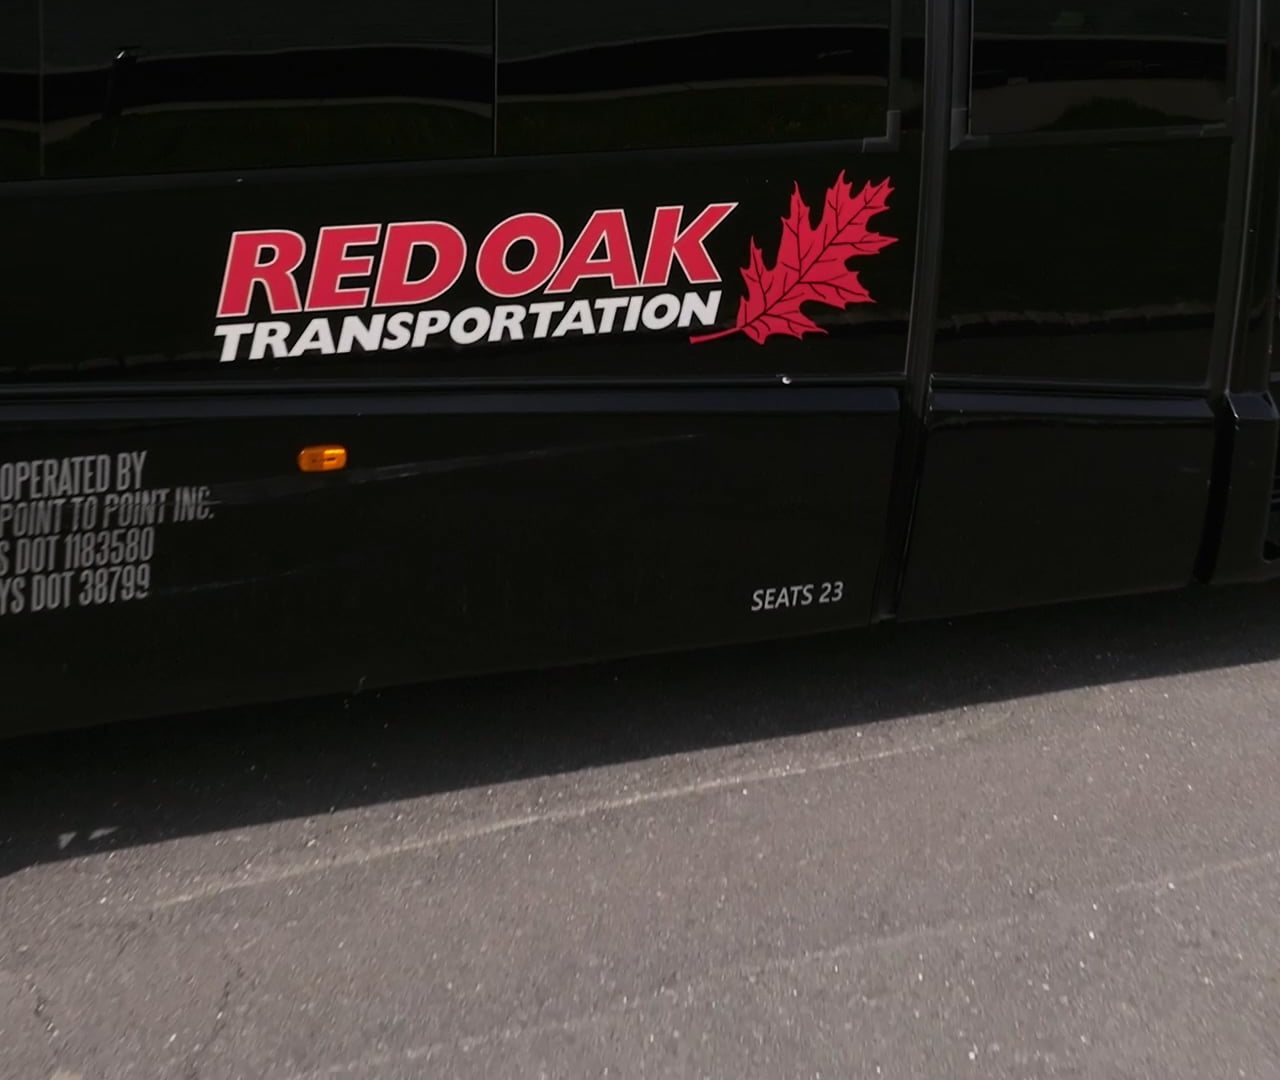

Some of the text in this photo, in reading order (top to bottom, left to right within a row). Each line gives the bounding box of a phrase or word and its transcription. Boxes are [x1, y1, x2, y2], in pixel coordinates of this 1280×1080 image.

[216, 201, 739, 319] RED OAK
[214, 289, 722, 363] TRANSPORTATION
[0, 454, 111, 501] OPERATED
[116, 451, 147, 491] BY
[72, 496, 98, 531] TO
[103, 489, 170, 528] POINT
[173, 486, 215, 521] INC.
[15, 535, 60, 574] DOT
[65, 527, 155, 570] 1183580
[31, 572, 74, 611] DOT
[79, 564, 150, 606] 38799
[751, 581, 843, 611] SEATS 23
